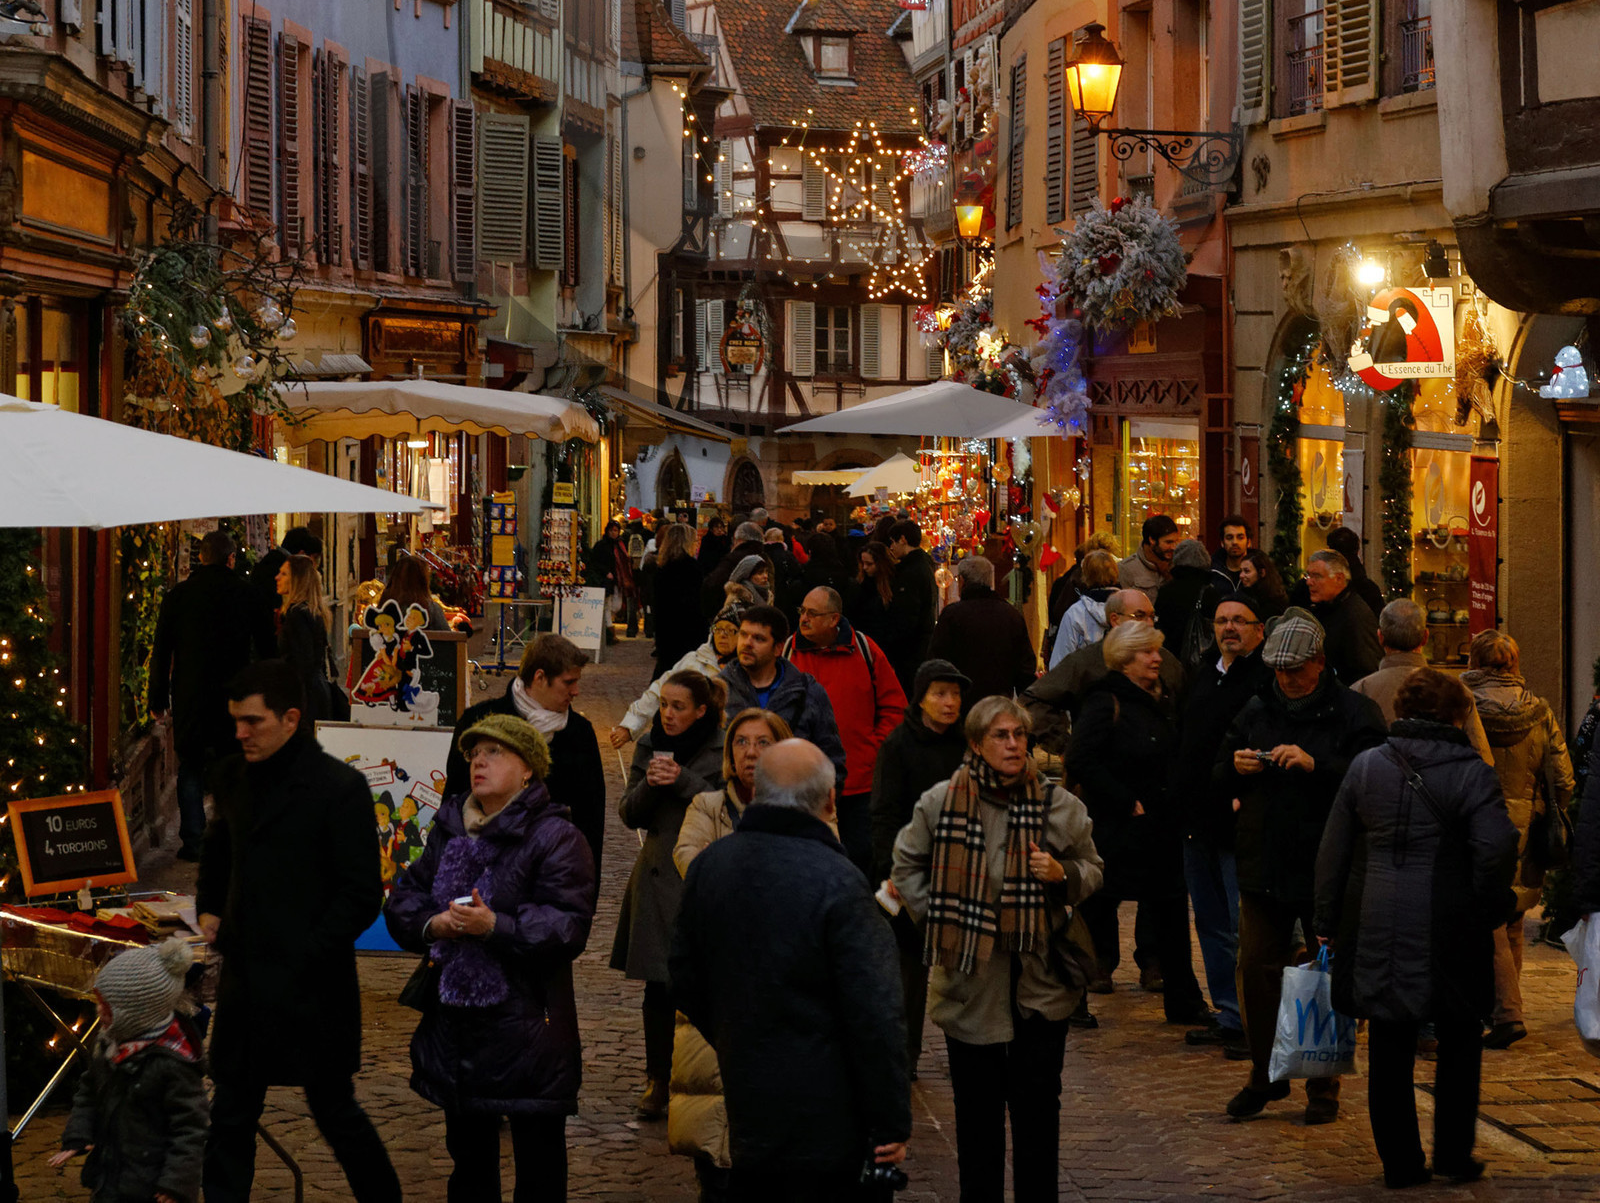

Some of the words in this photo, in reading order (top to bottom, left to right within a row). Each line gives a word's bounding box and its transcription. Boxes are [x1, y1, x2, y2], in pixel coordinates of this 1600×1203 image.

[1381, 364, 1422, 375] L'Essence
[1424, 363, 1435, 374] du
[1437, 363, 1453, 373] Thé
[45, 814, 63, 833] 10
[65, 817, 98, 832] EUROS
[44, 839, 55, 856] 4
[56, 838, 108, 855] TORCHONS
